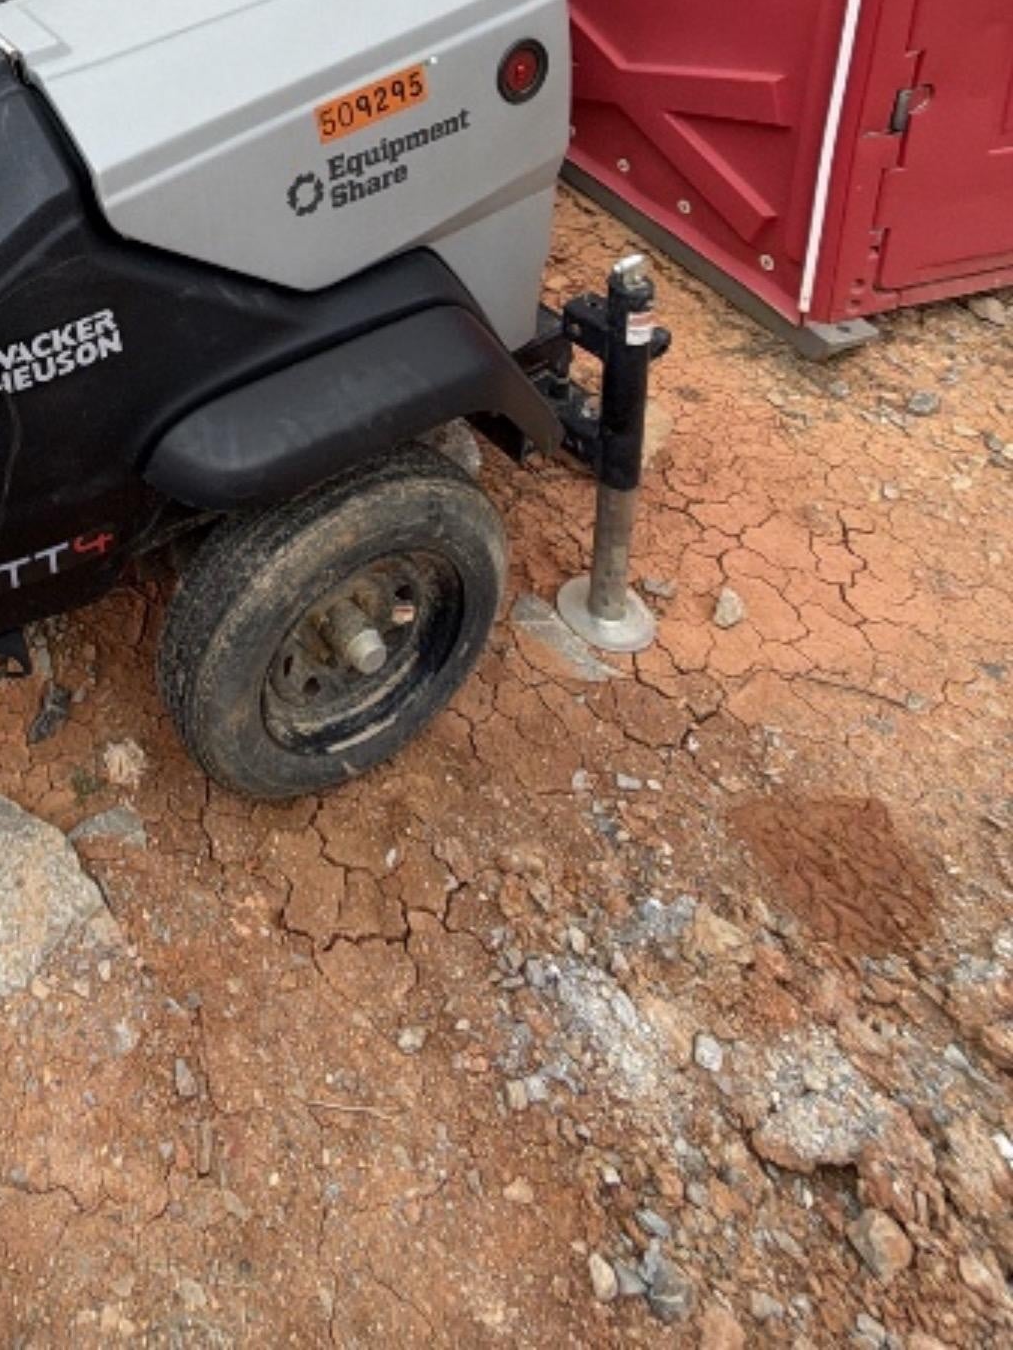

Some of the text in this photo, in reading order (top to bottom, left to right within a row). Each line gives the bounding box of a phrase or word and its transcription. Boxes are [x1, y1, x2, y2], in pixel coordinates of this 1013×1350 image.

[319, 71, 424, 136] 509295
[327, 107, 471, 181] Equipment
[330, 164, 408, 209] Share
